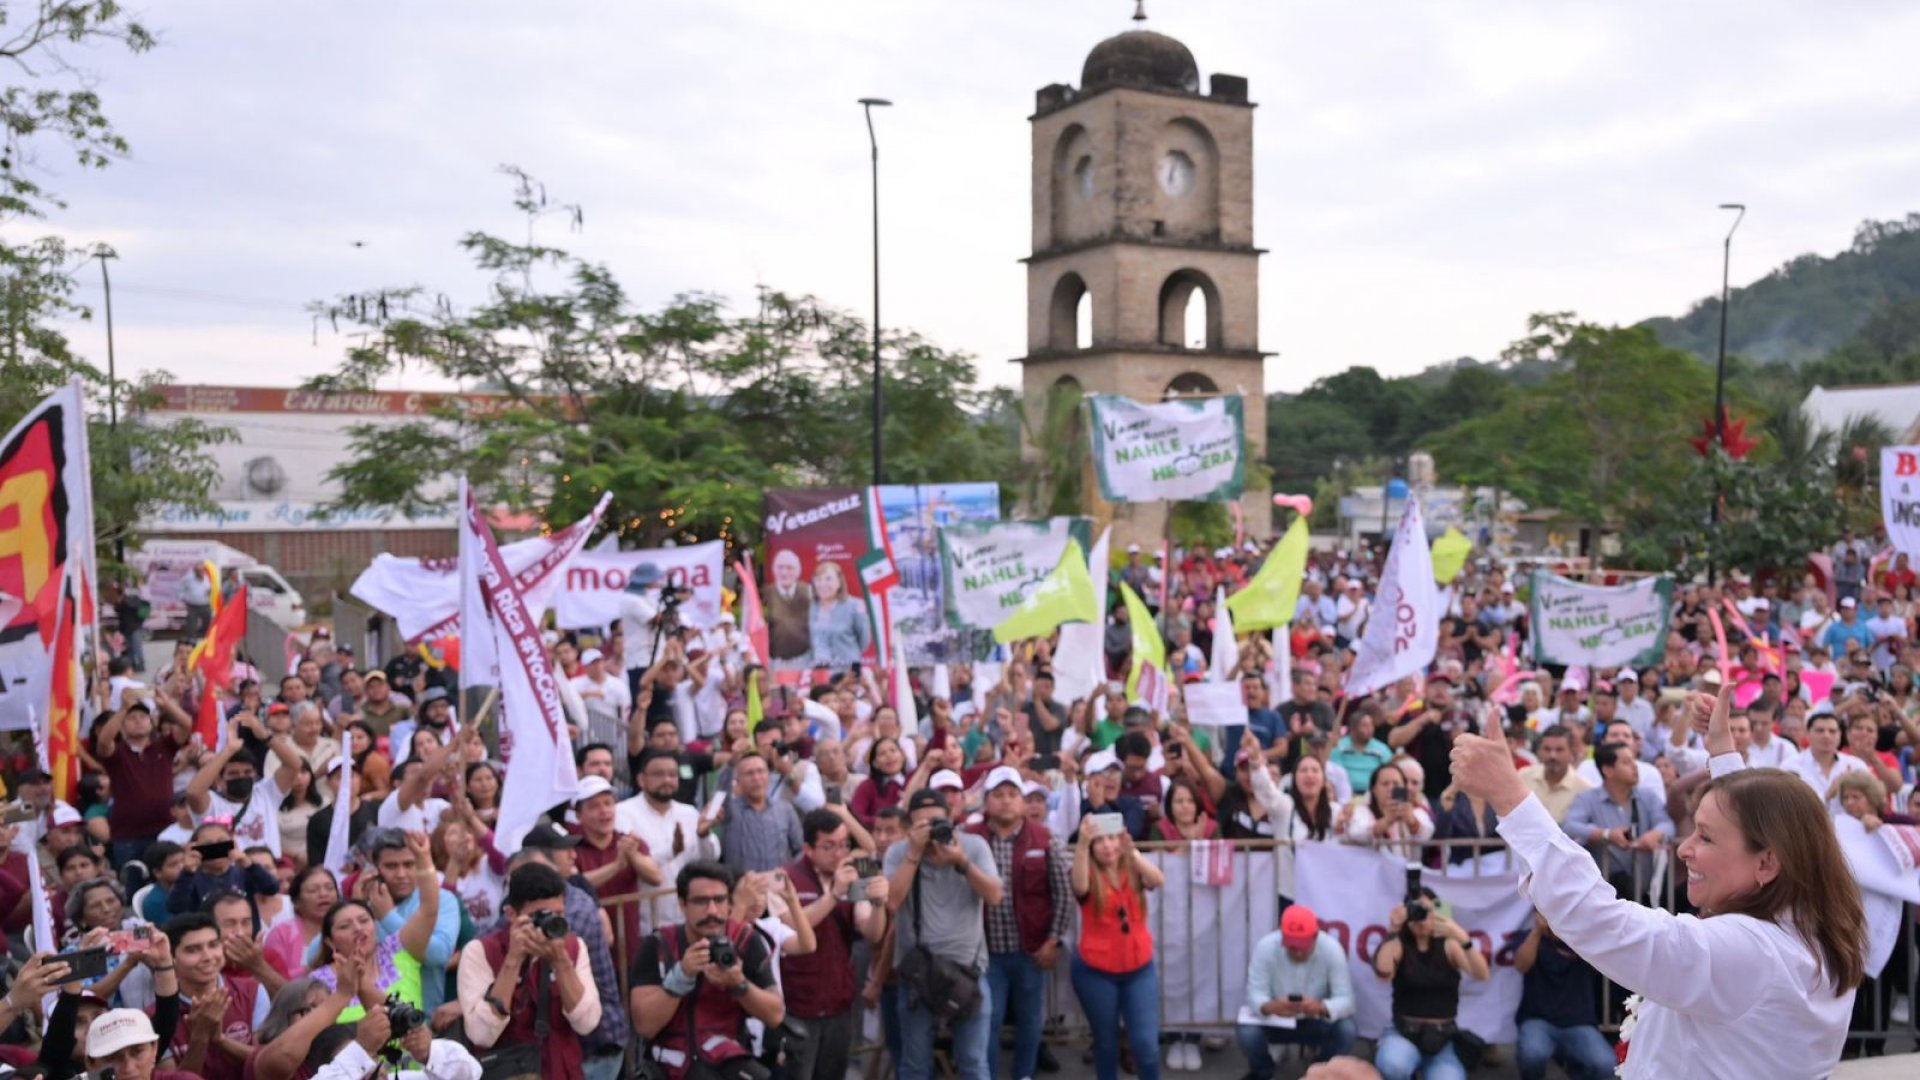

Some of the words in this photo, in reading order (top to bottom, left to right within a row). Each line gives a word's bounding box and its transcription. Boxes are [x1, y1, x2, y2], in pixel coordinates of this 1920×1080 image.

[1115, 437, 1181, 465] NAHLE
[1151, 450, 1233, 481] HEERA
[767, 494, 862, 534] Veracruz
[567, 563, 712, 592] mona
[963, 561, 1027, 591] NAHLE
[494, 587, 526, 636] Rica
[1548, 612, 1610, 630] NAHLE
[1577, 621, 1657, 649] HEERA
